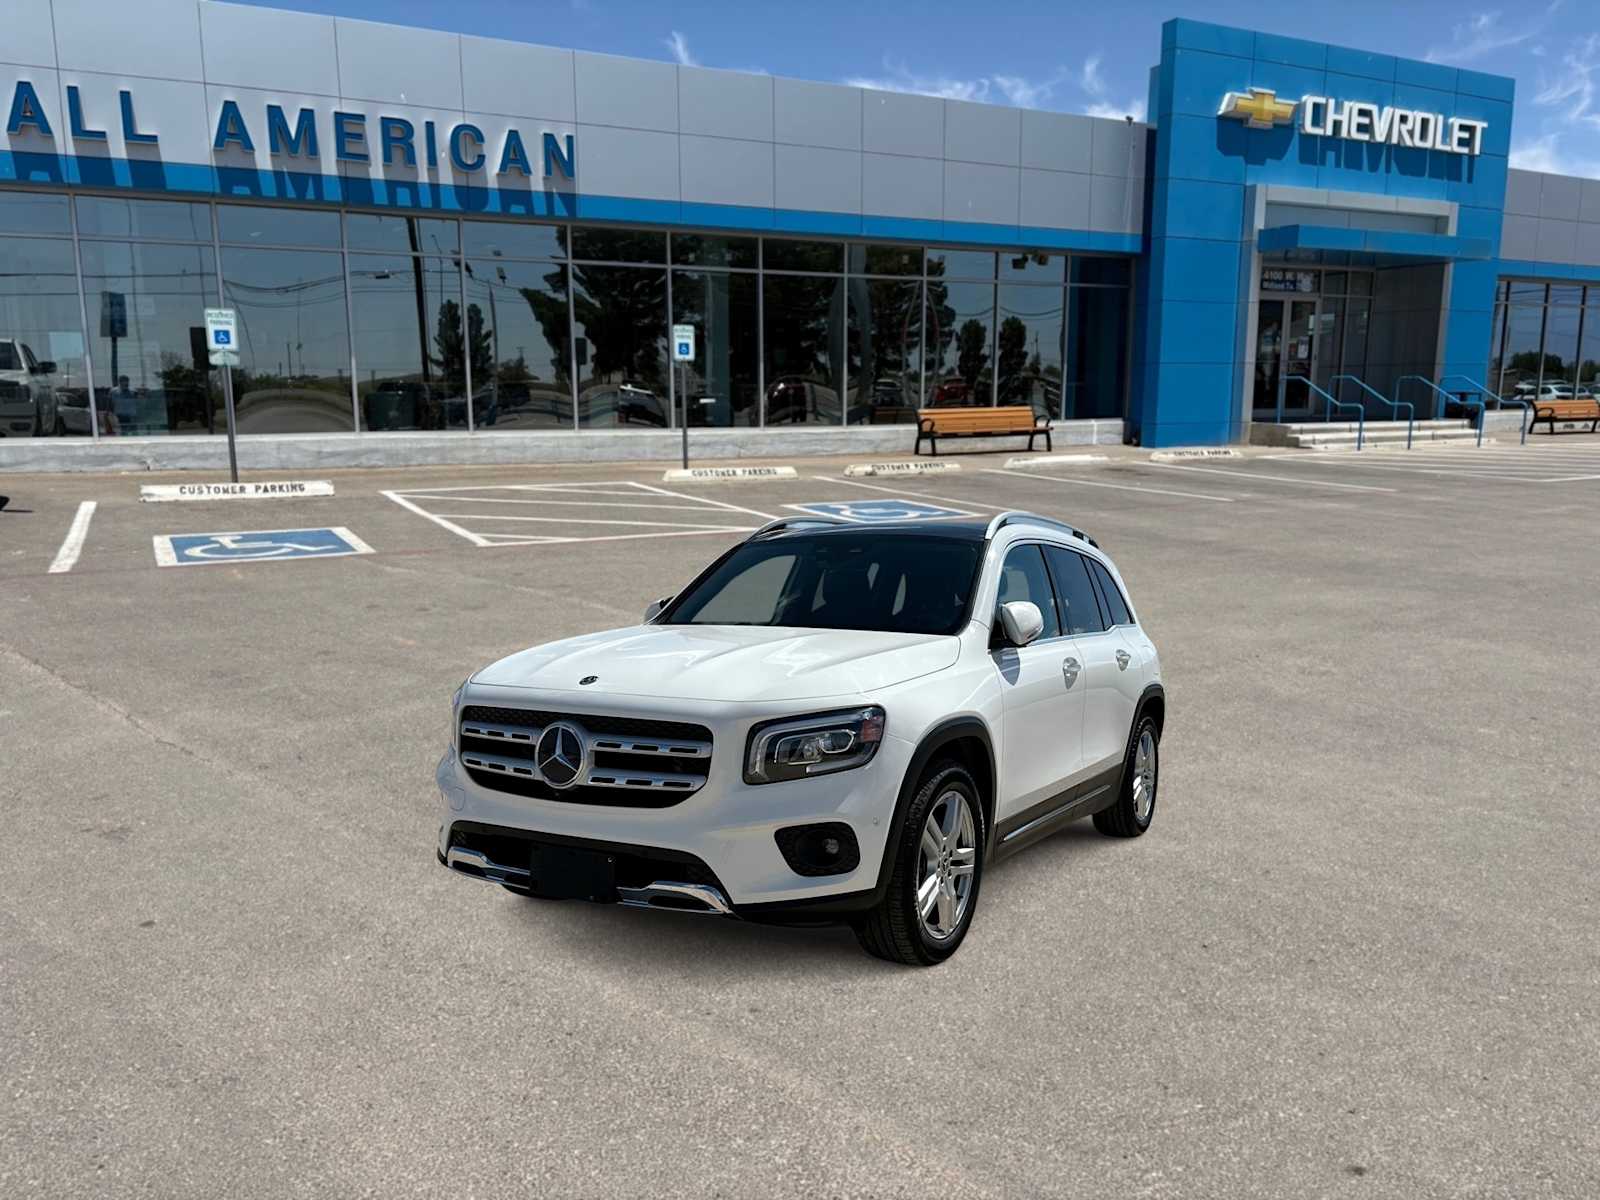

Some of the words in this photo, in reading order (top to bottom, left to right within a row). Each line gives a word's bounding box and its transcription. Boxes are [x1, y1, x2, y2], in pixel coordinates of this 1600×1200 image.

[7, 80, 159, 144] ALL
[213, 100, 576, 179] AMERICAN
[1301, 94, 1489, 156] CHEVROLET
[691, 469, 737, 477] CUSTOMER
[871, 463, 910, 471] CUSTOMER
[179, 485, 247, 495] CUSTOMER
[254, 483, 306, 493] PARKING
